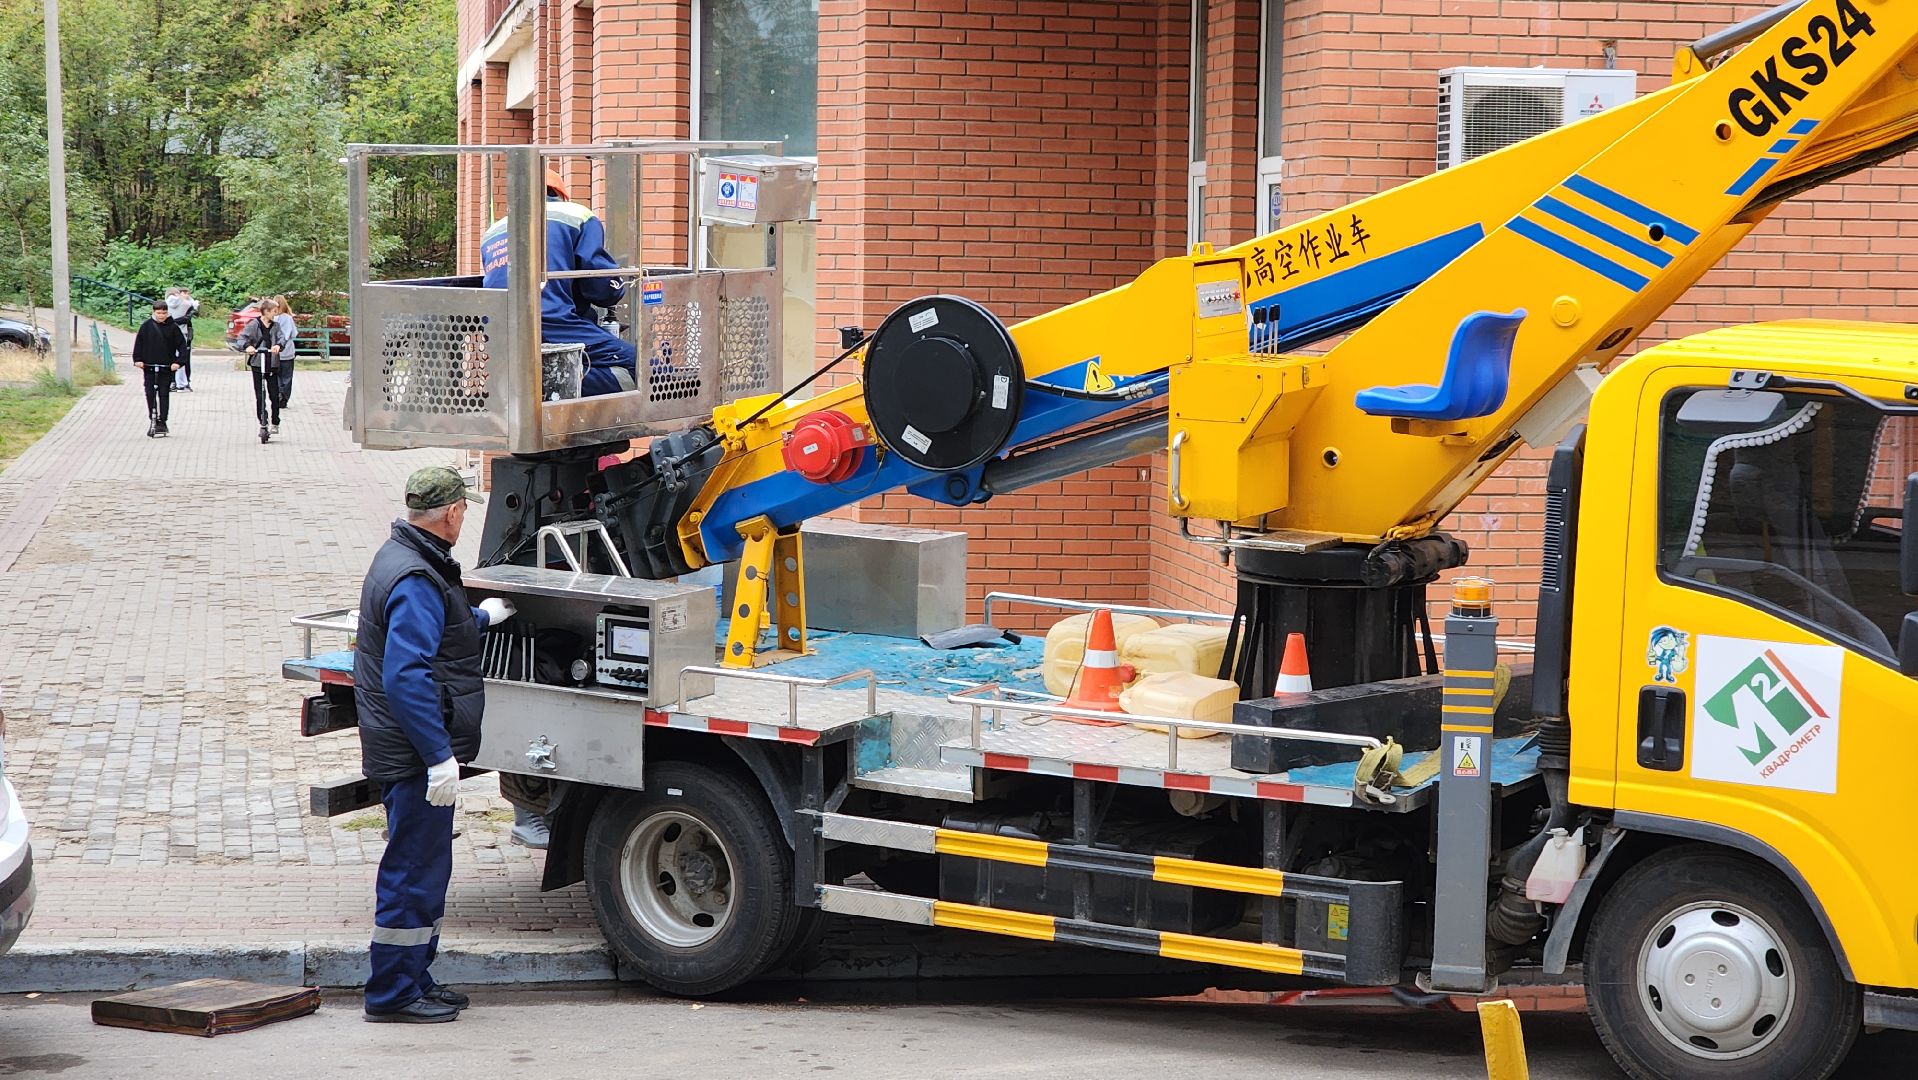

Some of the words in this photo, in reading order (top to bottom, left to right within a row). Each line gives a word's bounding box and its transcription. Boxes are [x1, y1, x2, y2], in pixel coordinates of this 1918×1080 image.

[1728, 0, 1876, 137] GKS24
[1250, 213, 1371, 287] 高空作业车
[1759, 724, 1822, 779] КВАДРОМЕТР
